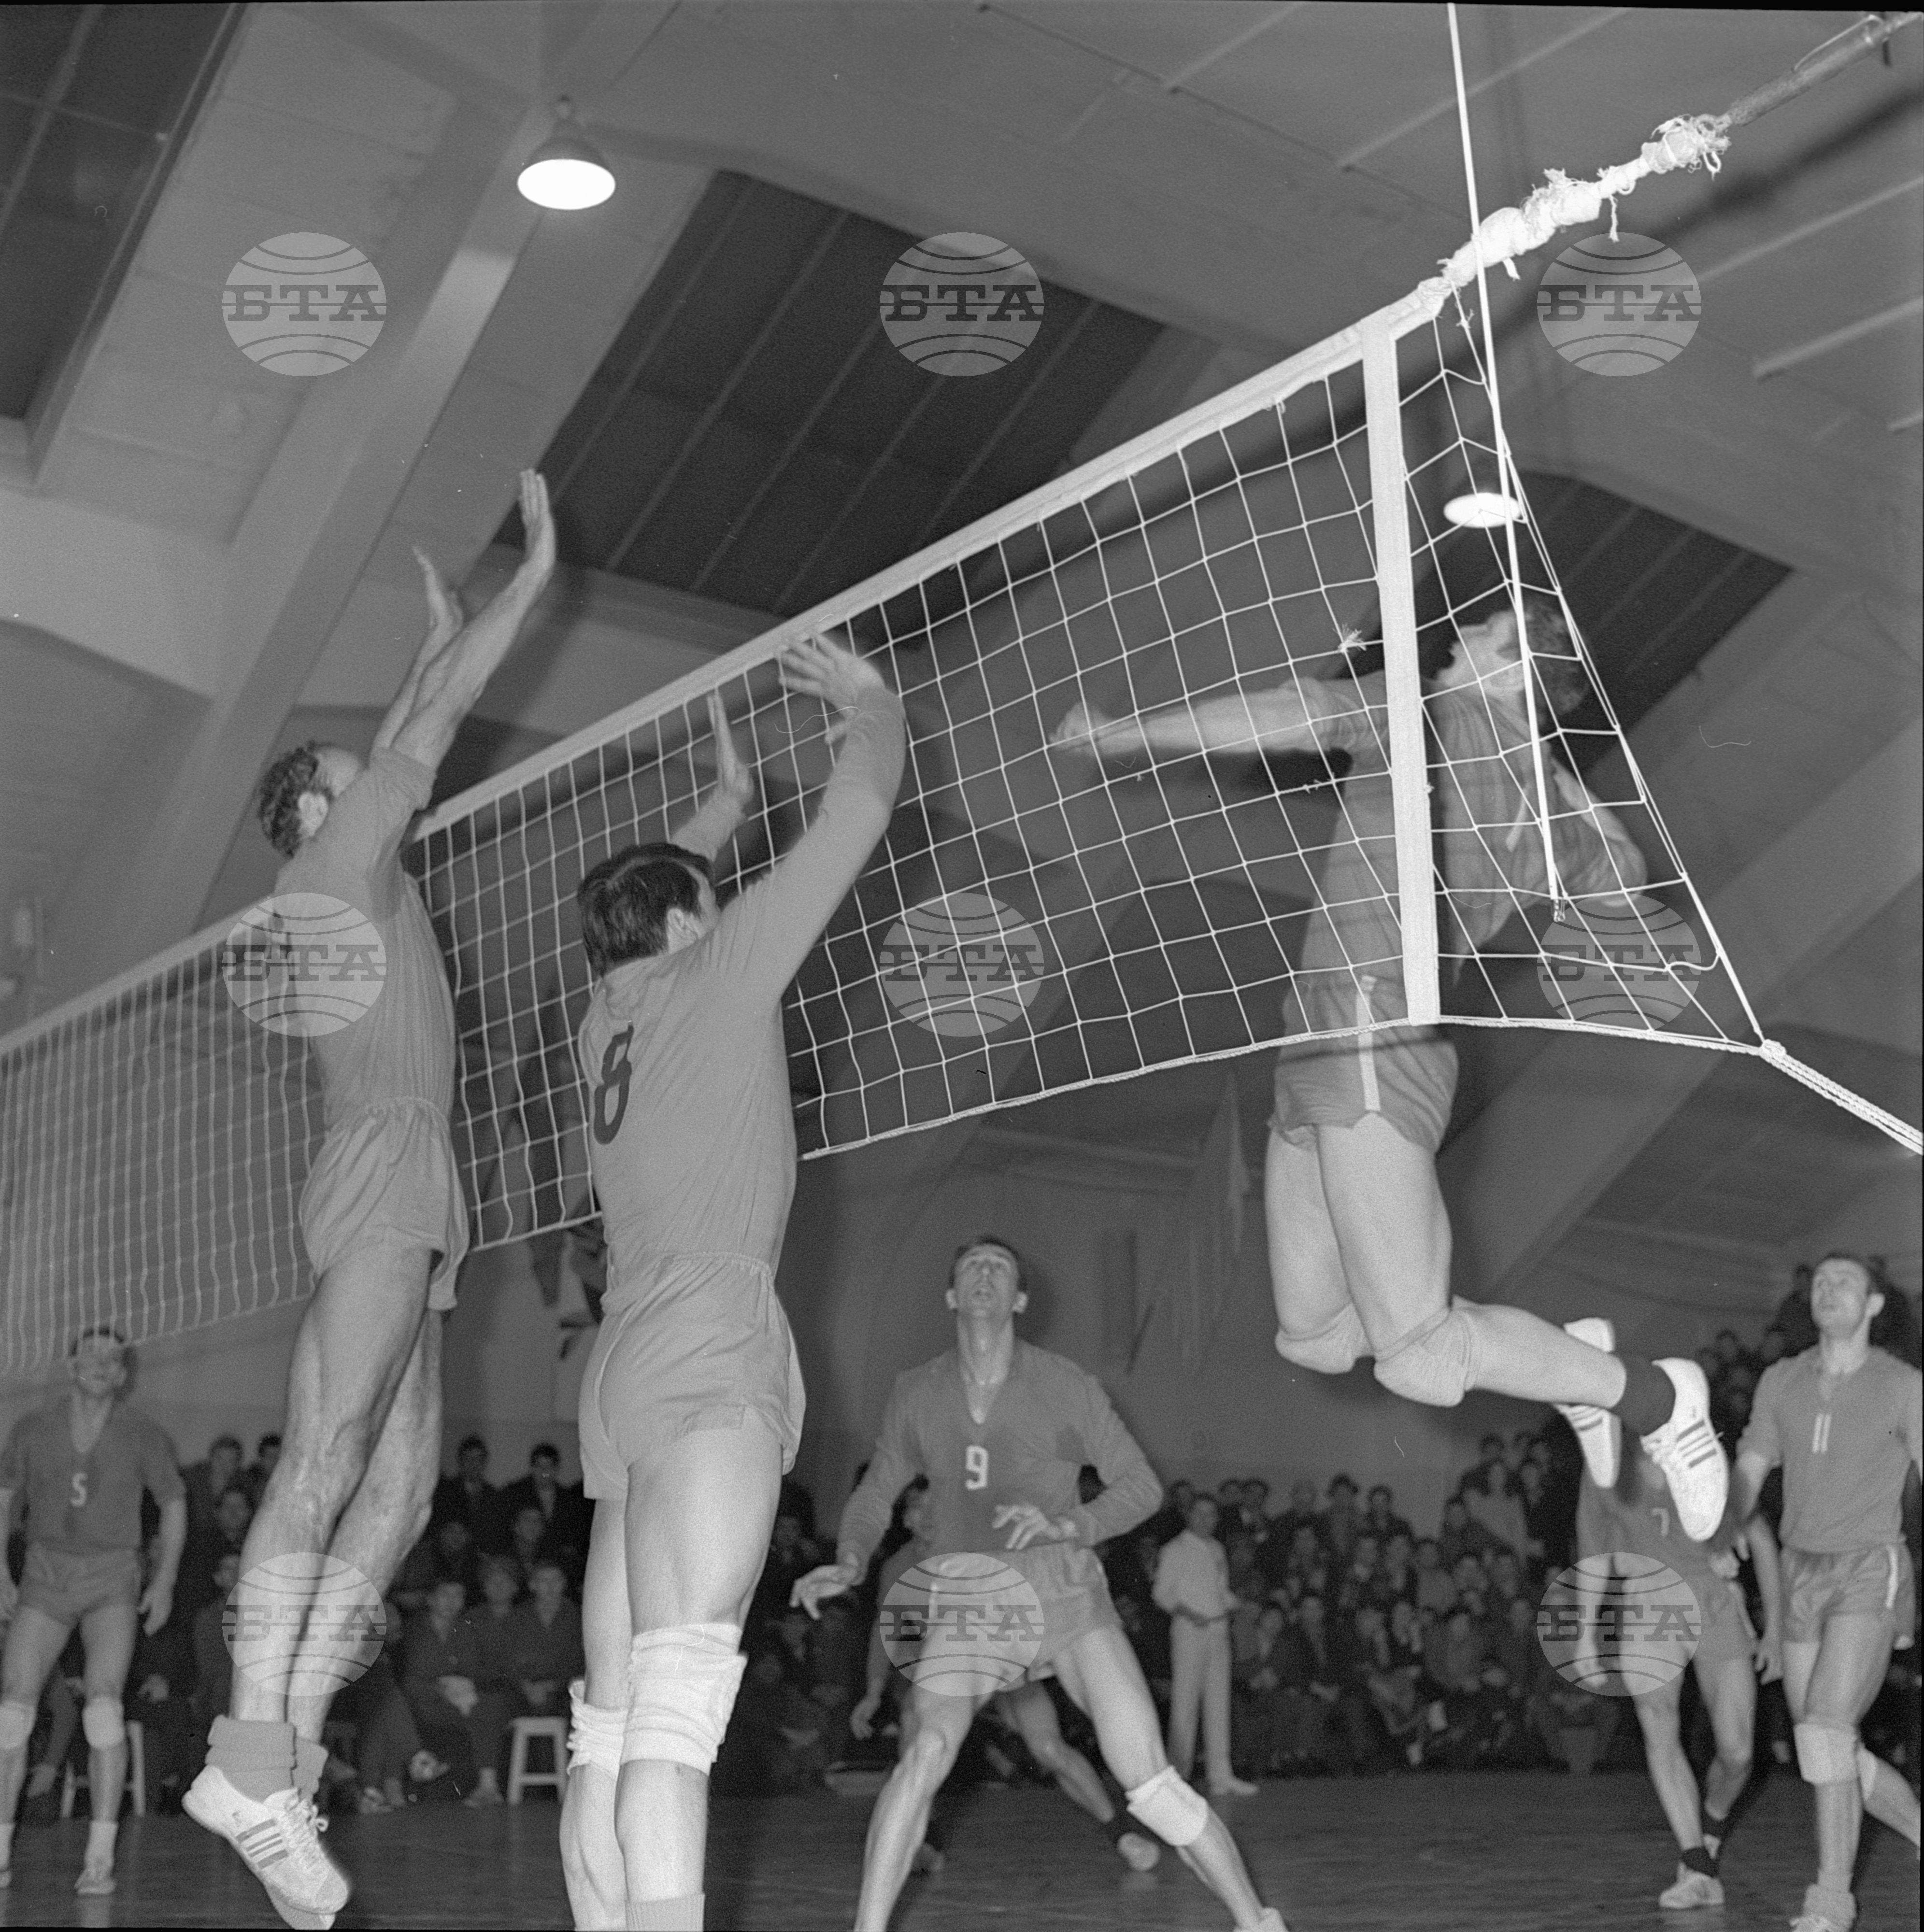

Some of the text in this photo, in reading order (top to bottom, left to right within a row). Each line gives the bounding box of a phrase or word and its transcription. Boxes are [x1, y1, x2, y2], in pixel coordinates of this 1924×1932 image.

[594, 1024, 635, 1146] 8
[1812, 1413, 1832, 1455] 11
[966, 1445, 988, 1490] 9
[1650, 1507, 1670, 1536] 7
